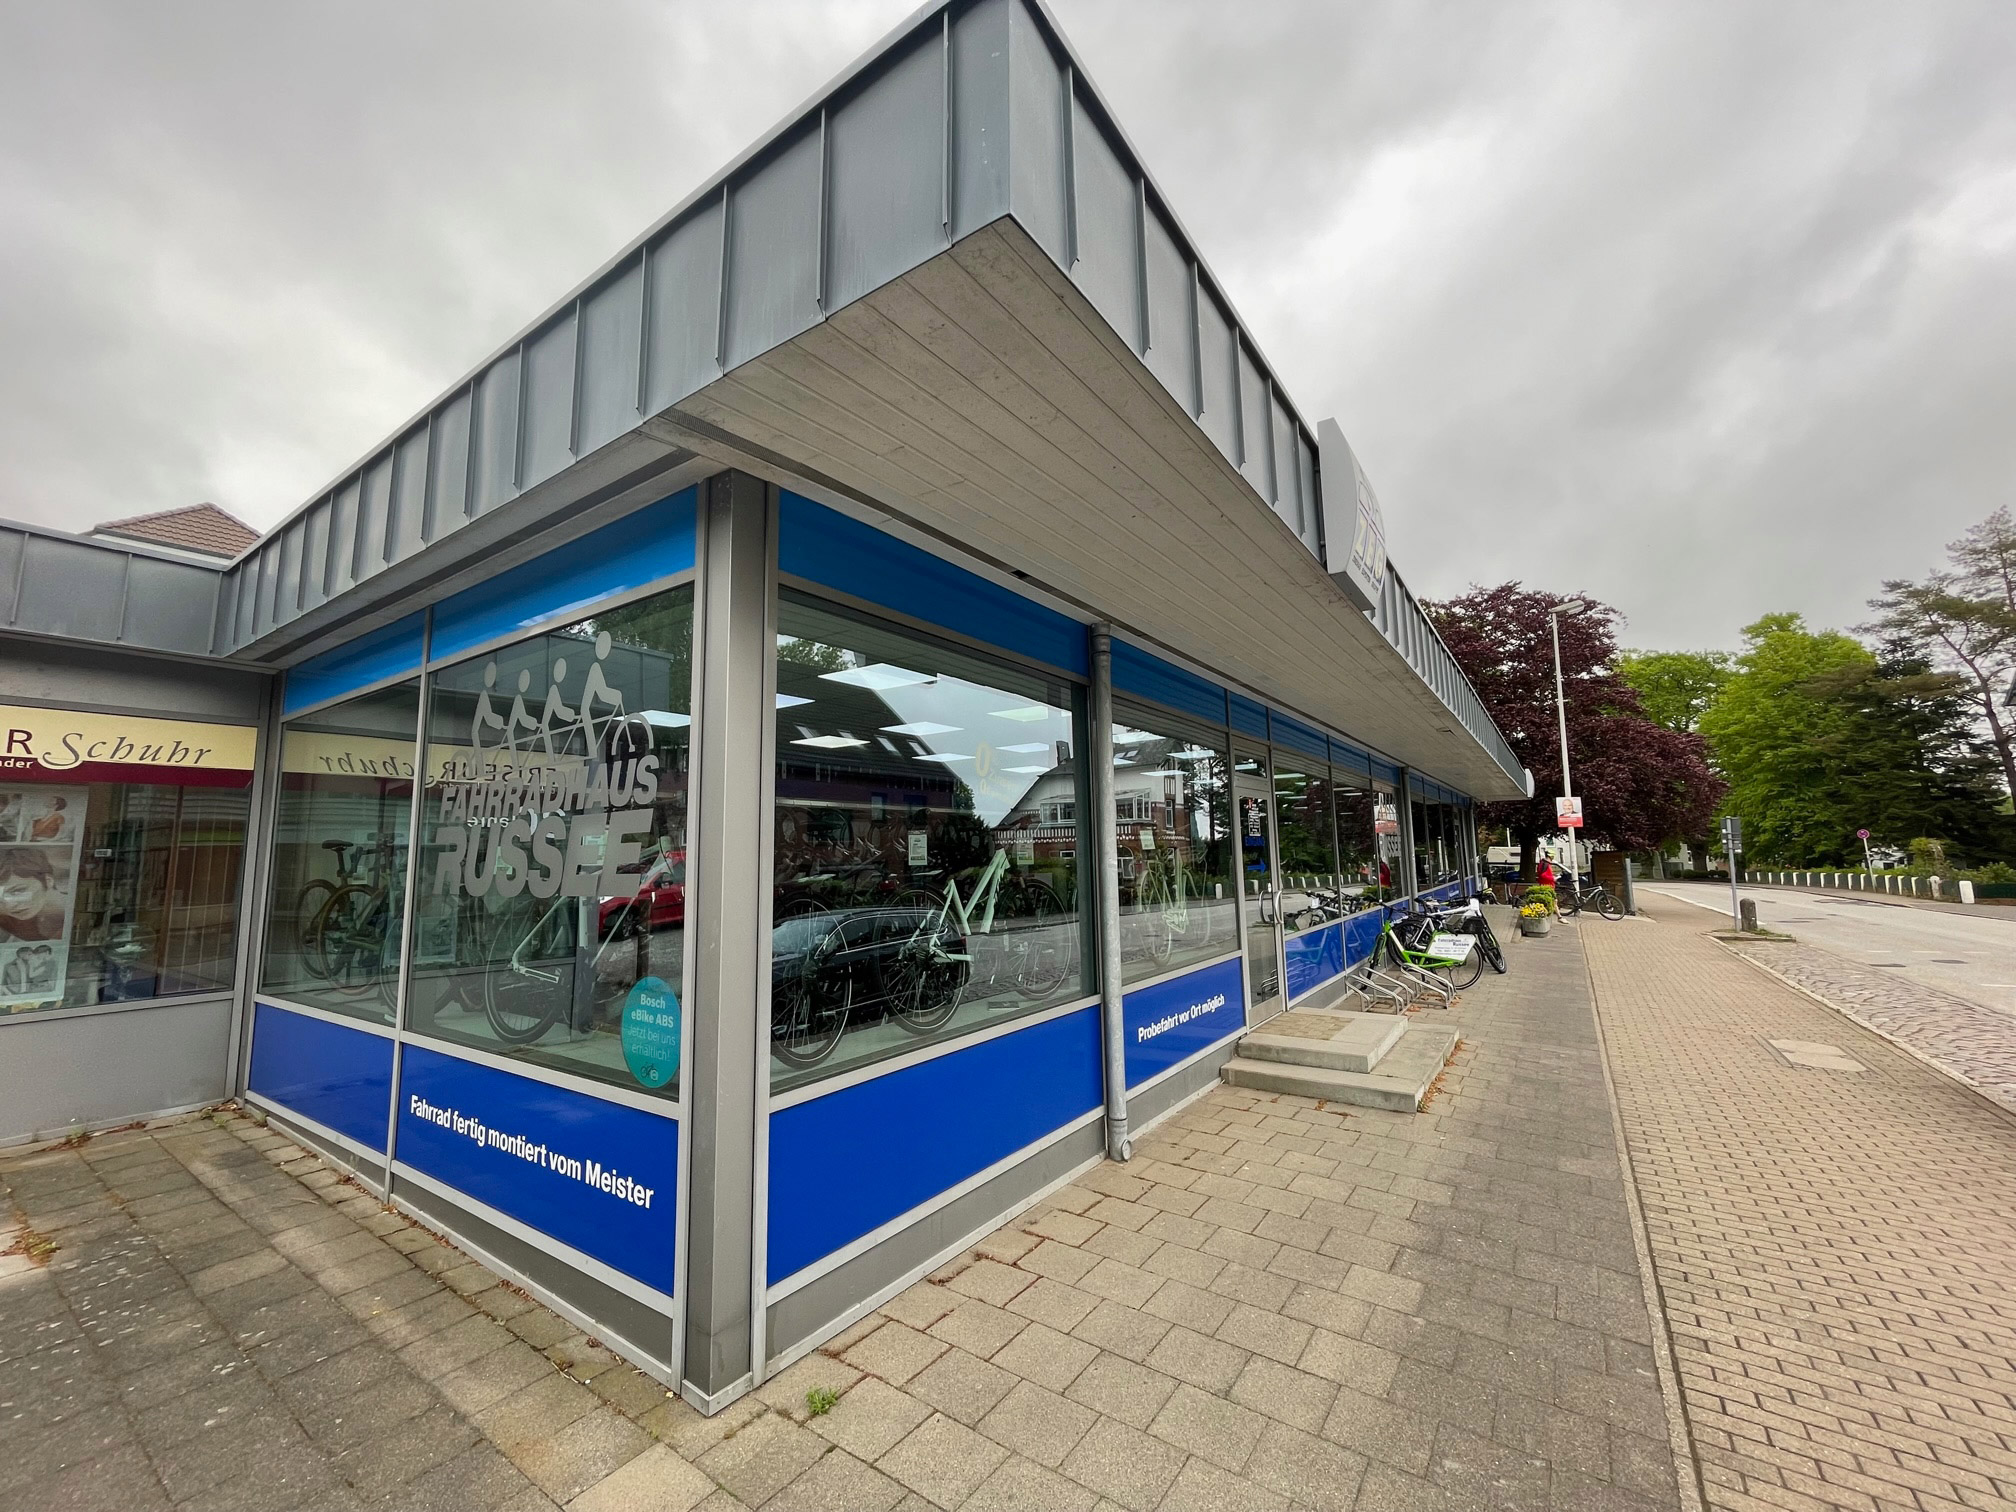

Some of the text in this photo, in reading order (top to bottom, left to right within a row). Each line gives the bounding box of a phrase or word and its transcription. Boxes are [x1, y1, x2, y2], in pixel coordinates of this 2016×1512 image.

[42, 732, 212, 766] Schuhr
[438, 755, 660, 824] FAHRRADHAUS
[433, 808, 654, 899] RUSSEE
[631, 1009, 674, 1028] eBike ABS
[640, 993, 666, 1009] Bosch
[1138, 993, 1225, 1043] Probefahrt vor Ort möglich
[627, 1024, 676, 1046] Jetzt bei uns
[410, 1094, 655, 1209] Fahrrad fertig montiert vom Meister
